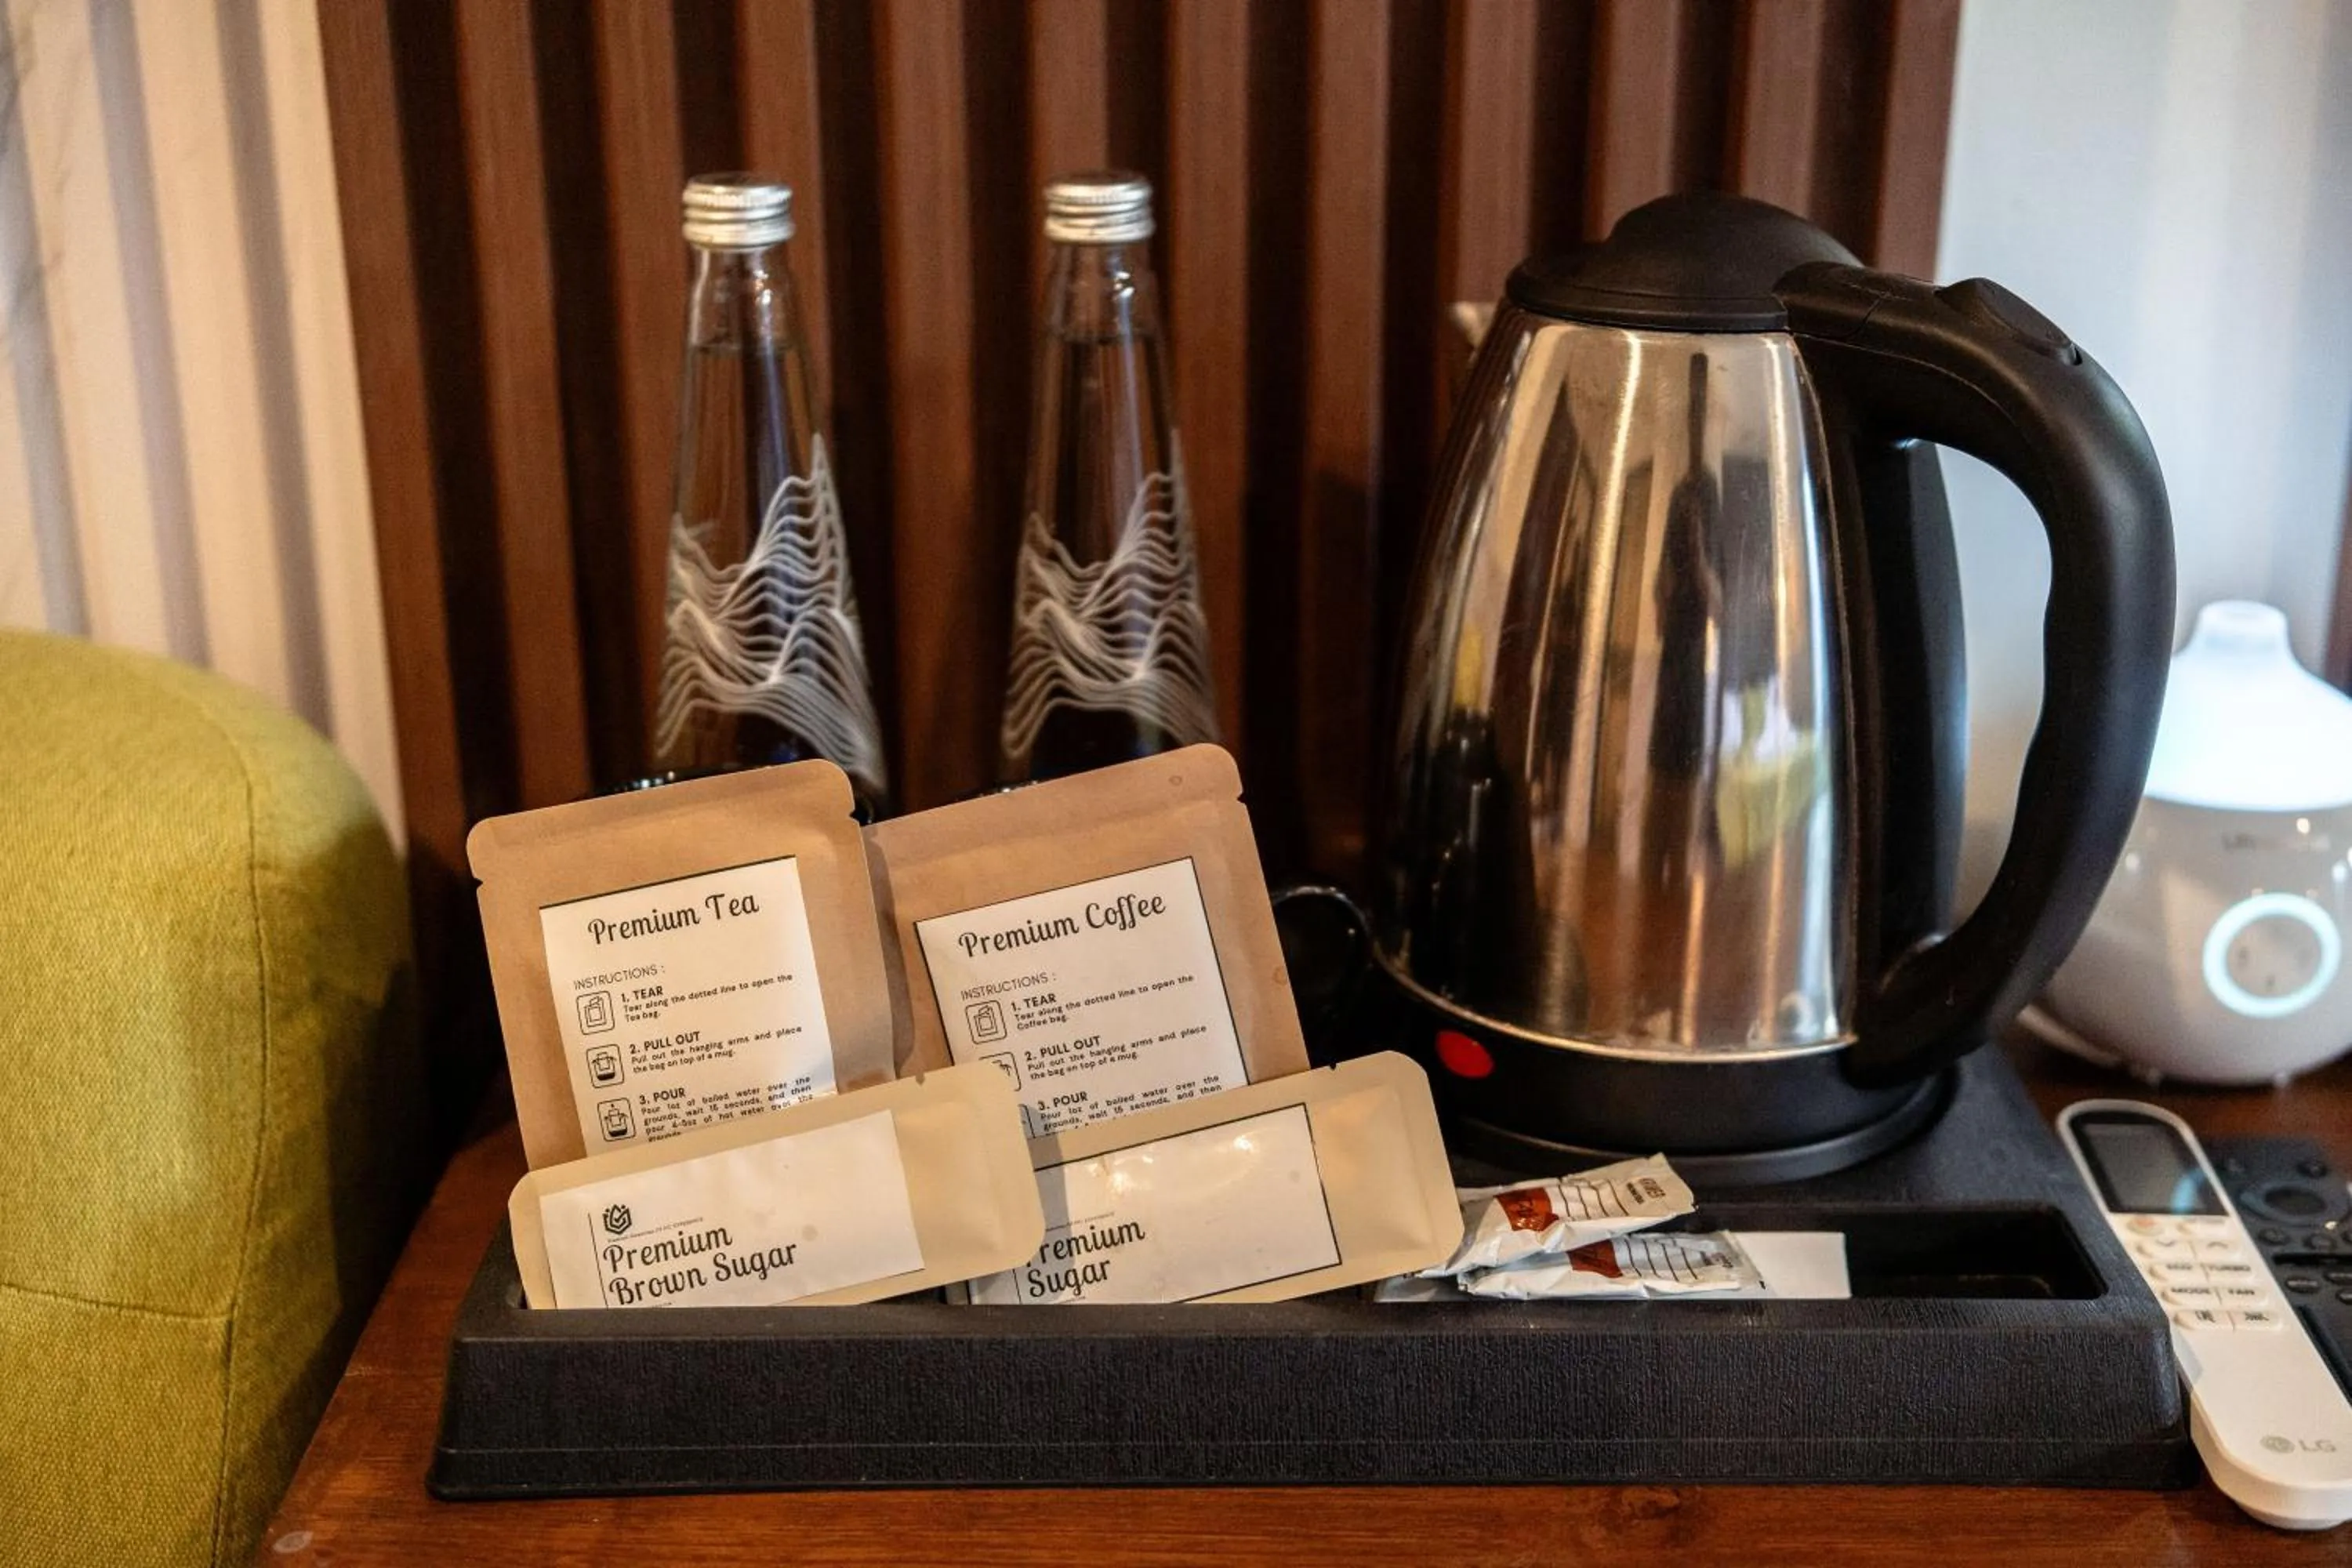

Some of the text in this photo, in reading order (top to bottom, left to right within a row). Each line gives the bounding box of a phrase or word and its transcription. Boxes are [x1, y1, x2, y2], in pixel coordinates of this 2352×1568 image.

[588, 894, 759, 944] Premium Tea
[958, 894, 1166, 957] Premium Coffee
[574, 965, 658, 989] INSTRUCTIONS
[960, 972, 1048, 1000] INSTRUCTIONS
[621, 986, 663, 1003] 1. TEAR
[624, 1004, 642, 1012] Tear
[645, 997, 668, 1010] along
[671, 995, 685, 1004] the
[688, 988, 717, 1000] dotted
[720, 984, 736, 993] line
[752, 978, 774, 989] open
[778, 974, 793, 982] the
[1011, 993, 1057, 1011] 1. TEAR
[1014, 1011, 1034, 1022] Tear
[1038, 1006, 1062, 1018] along
[1065, 1000, 1081, 1011] the
[1084, 993, 1116, 1006] dotted
[1118, 989, 1135, 999] line
[1152, 980, 1175, 991] open
[1178, 975, 1194, 984] the
[625, 1013, 641, 1022] Tea
[1017, 1018, 1047, 1031] Coffee
[630, 1031, 700, 1054] 2. PULL OUT
[631, 1055, 647, 1065] Pull
[689, 1041, 723, 1054] hanging
[728, 1036, 750, 1045] arms
[754, 1032, 771, 1040] and
[776, 1026, 802, 1038] place
[1025, 1036, 1102, 1061] 2. PULL OUT
[1027, 1025, 1207, 1071] Pull out the hanging arms and place
[649, 1061, 665, 1071] bag
[680, 1055, 695, 1066] top
[696, 1053, 706, 1062] of
[1047, 1067, 1065, 1077] bag
[1080, 1062, 1096, 1073] top
[1098, 1057, 1108, 1066] of
[639, 1087, 686, 1105] 3. POUR
[641, 1105, 660, 1115] Pour
[702, 1093, 728, 1103] boiled
[736, 1087, 760, 1098] water
[768, 1083, 787, 1092] over
[795, 1076, 811, 1085] the
[686, 1108, 703, 1116] wait
[768, 1093, 785, 1102] and
[791, 1085, 811, 1094] then
[1038, 1091, 1088, 1111] 3. POUR
[1040, 1110, 1062, 1120] Pour
[1090, 1102, 1098, 1111] of
[1106, 1094, 1134, 1107] boiled
[1142, 1087, 1168, 1098] water
[1176, 1081, 1196, 1091] over
[1203, 1075, 1220, 1084] the
[1088, 1110, 1107, 1120] wait
[1177, 1091, 1194, 1101] and
[1200, 1084, 1222, 1095] then
[646, 1124, 665, 1135] pour
[719, 1111, 734, 1120] hot
[740, 1107, 764, 1116] water
[603, 1228, 733, 1273] Premium
[1026, 1221, 1145, 1267] remium
[608, 1243, 797, 1305] Brown Sugar
[1027, 1260, 1110, 1298] Sugar
[2298, 1439, 2336, 1452] LG
